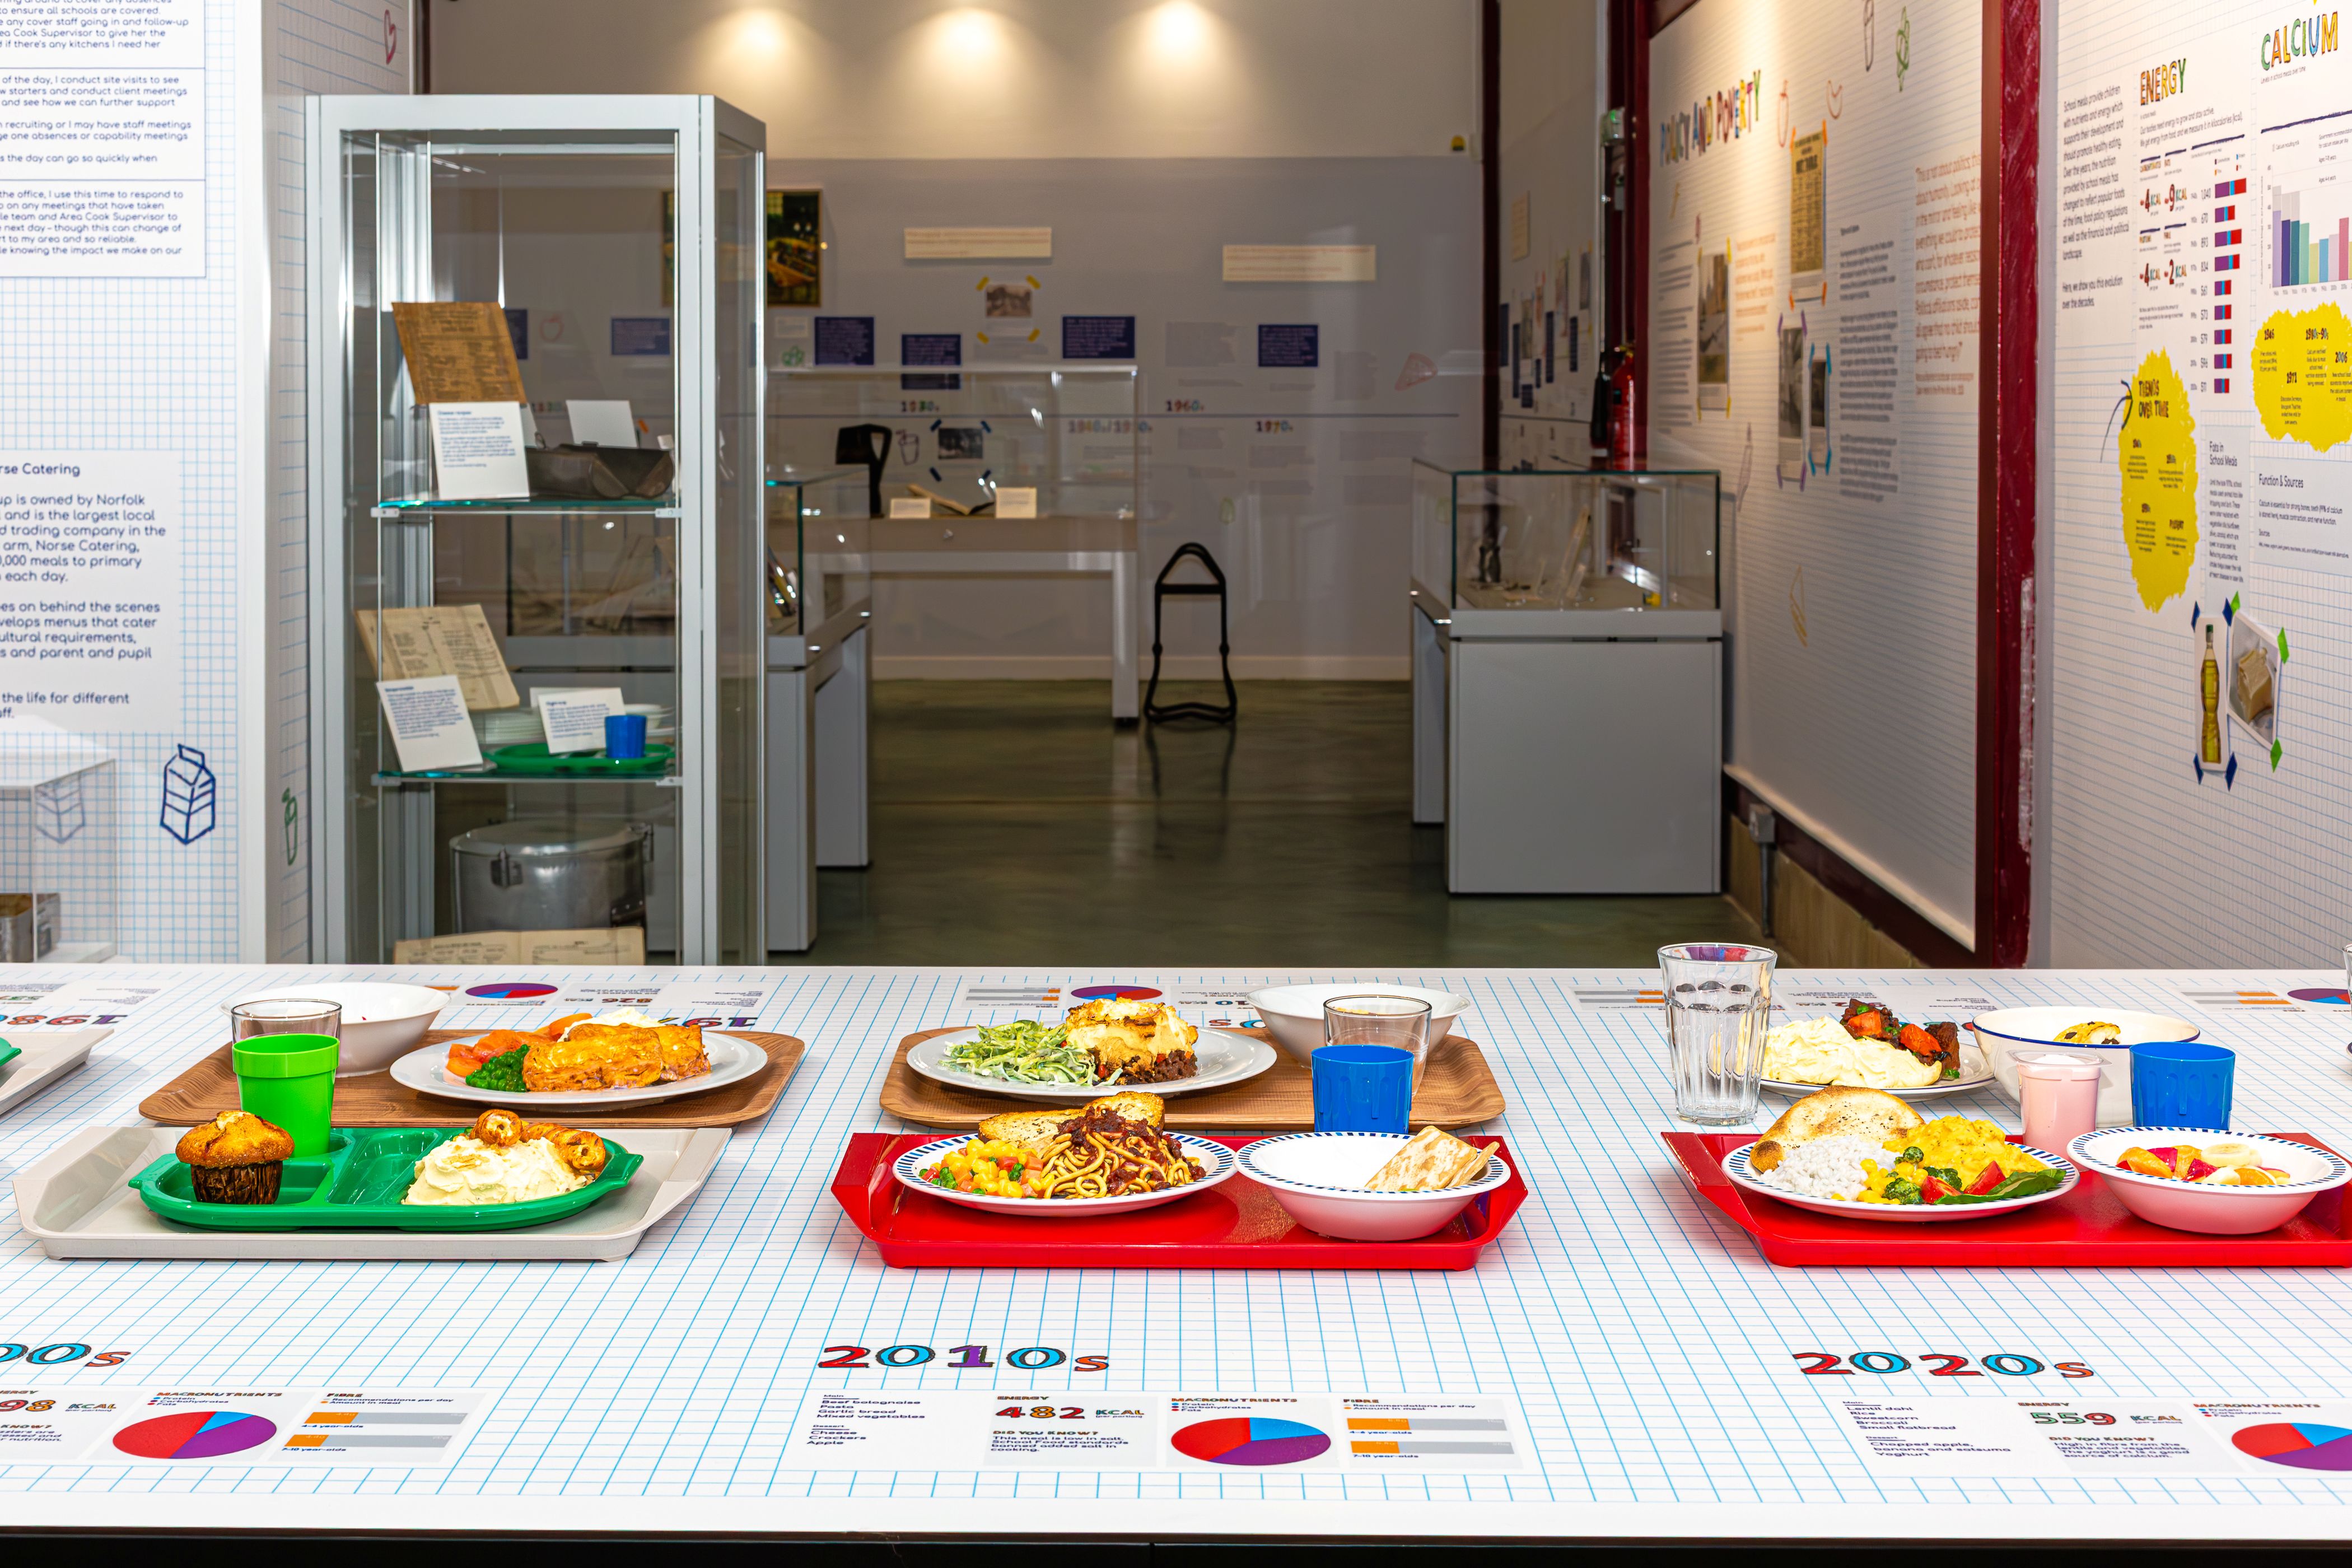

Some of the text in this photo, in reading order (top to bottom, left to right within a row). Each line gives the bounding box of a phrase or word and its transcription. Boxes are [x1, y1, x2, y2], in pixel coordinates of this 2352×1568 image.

[6, 19, 24, 27] any
[56, 17, 78, 26] staff
[80, 19, 108, 27] going
[144, 17, 189, 27] follow-up
[2261, 11, 2338, 71] CALCIUM
[2, 75, 12, 84] of
[14, 76, 30, 84] the
[32, 76, 53, 85] day,
[2140, 58, 2186, 105] ENERGY
[1692, 96, 1713, 156] AND
[1716, 69, 1761, 143] POVERTY
[2209, 441, 2220, 453] Fats
[2209, 454, 2238, 467] School Meals
[22, 462, 81, 478] Catering
[2258, 474, 2304, 489] Function & Sources
[16, 494, 145, 508] is owned by Norfolk
[4, 509, 155, 524] and is the largest local
[11, 525, 166, 539] trading company in the
[3, 539, 140, 554] arm, Norse Catering,
[818, 1345, 1109, 1373] 2010s
[1792, 1351, 2095, 1378] 2020s
[995, 1406, 1085, 1419] 482
[2030, 1412, 2117, 1425] 559
